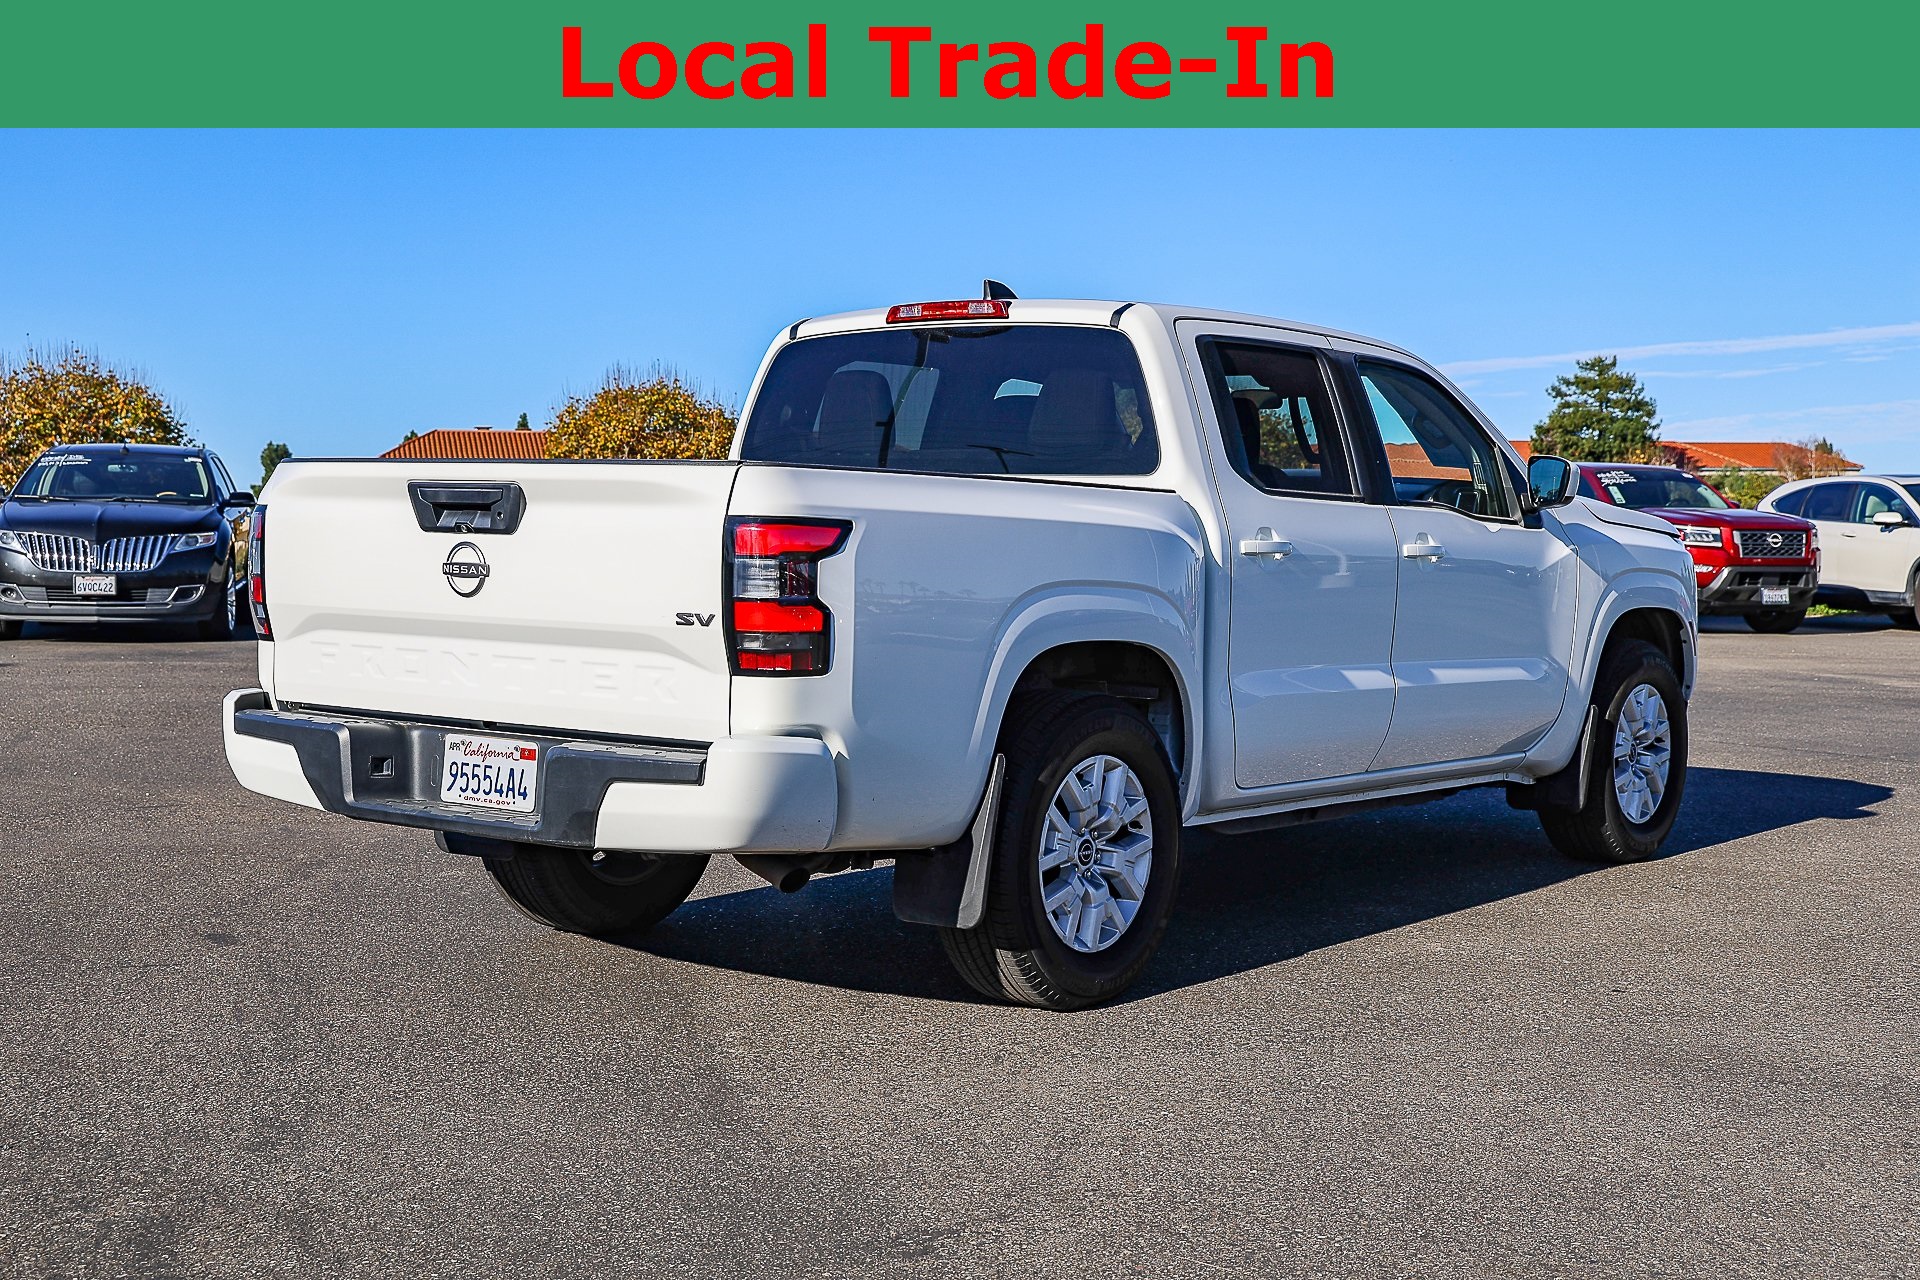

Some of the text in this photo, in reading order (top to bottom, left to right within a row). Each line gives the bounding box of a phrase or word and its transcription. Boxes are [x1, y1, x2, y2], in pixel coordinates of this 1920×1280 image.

[443, 564, 487, 576] NISSAN
[675, 612, 716, 628] SV
[306, 640, 679, 705] FRONTIER
[448, 741, 461, 751] APR
[464, 741, 520, 762] California
[447, 761, 528, 800] 95554A4
[463, 795, 511, 805] dmv.ca.gov
